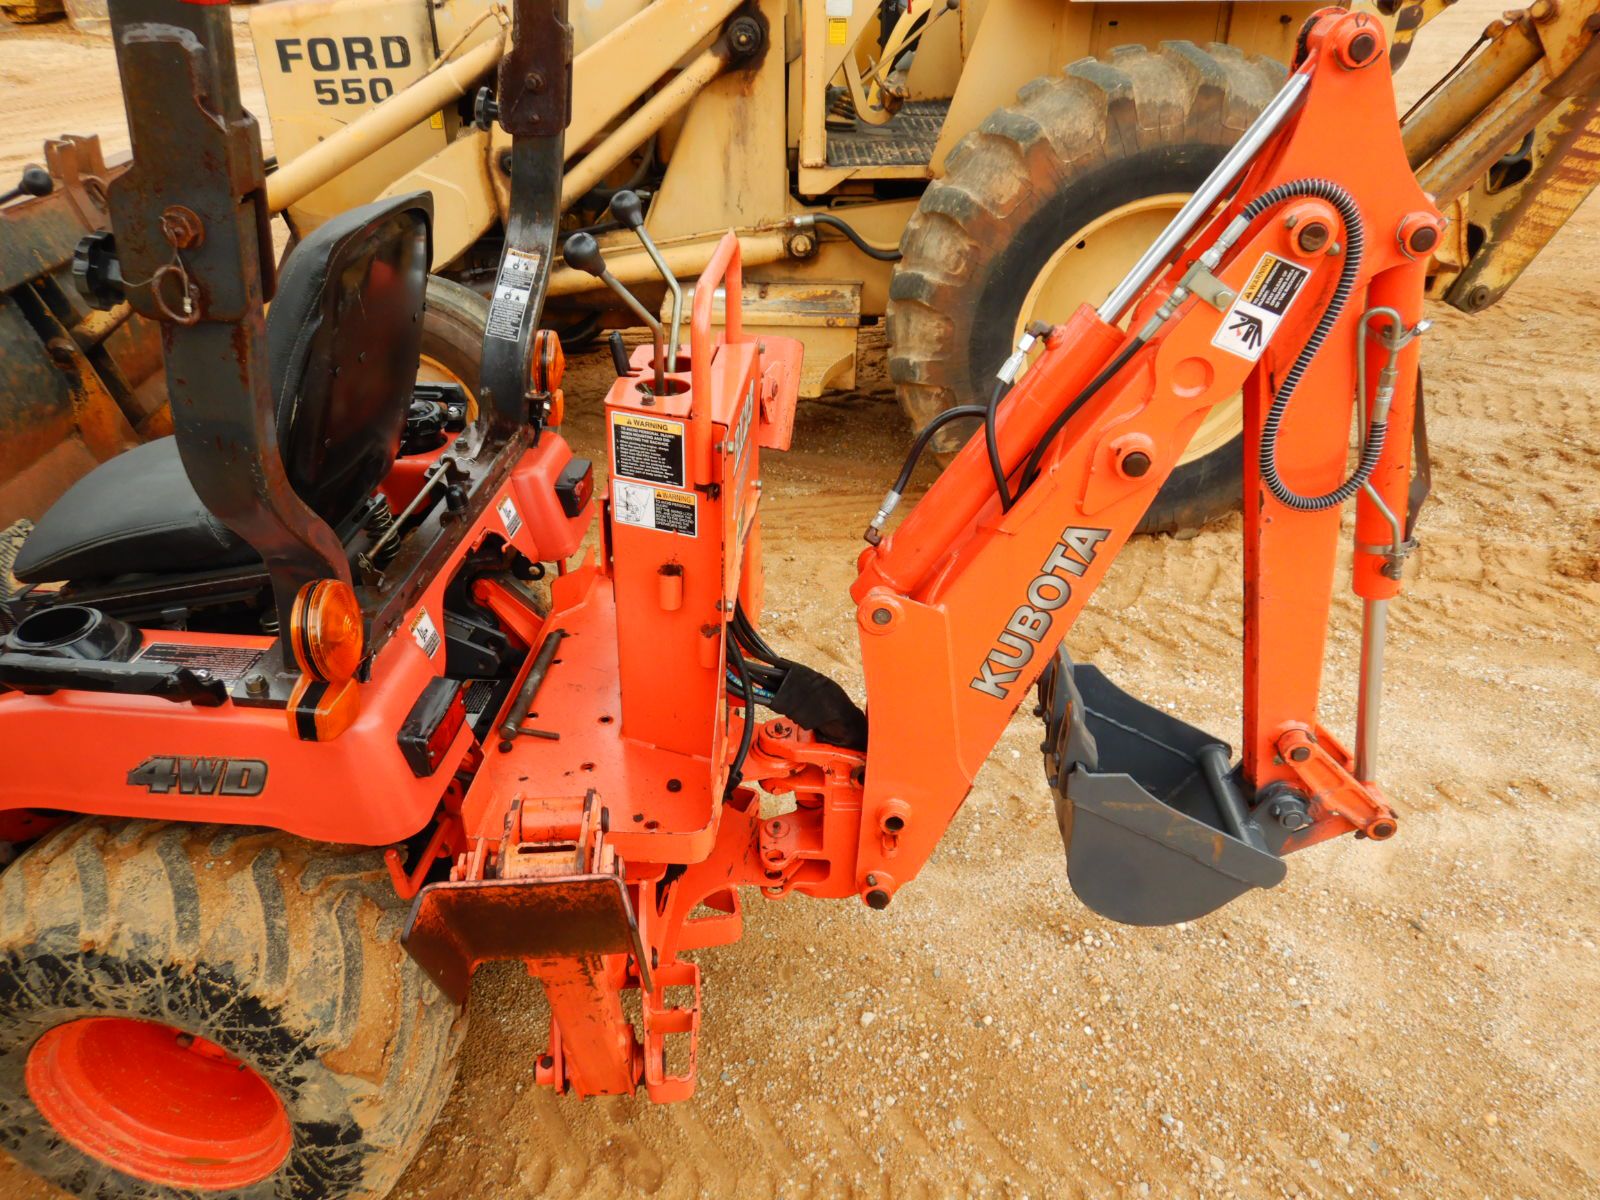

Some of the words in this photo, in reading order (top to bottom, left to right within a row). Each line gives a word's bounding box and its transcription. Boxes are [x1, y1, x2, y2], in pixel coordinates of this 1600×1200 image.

[275, 36, 411, 73] FORD
[313, 78, 394, 105] 550
[1248, 257, 1272, 290] WARNING
[633, 419, 668, 431] WARNING
[662, 492, 691, 503] WARNING
[969, 526, 1112, 700] KUBOTA
[127, 755, 268, 796] 4WD
